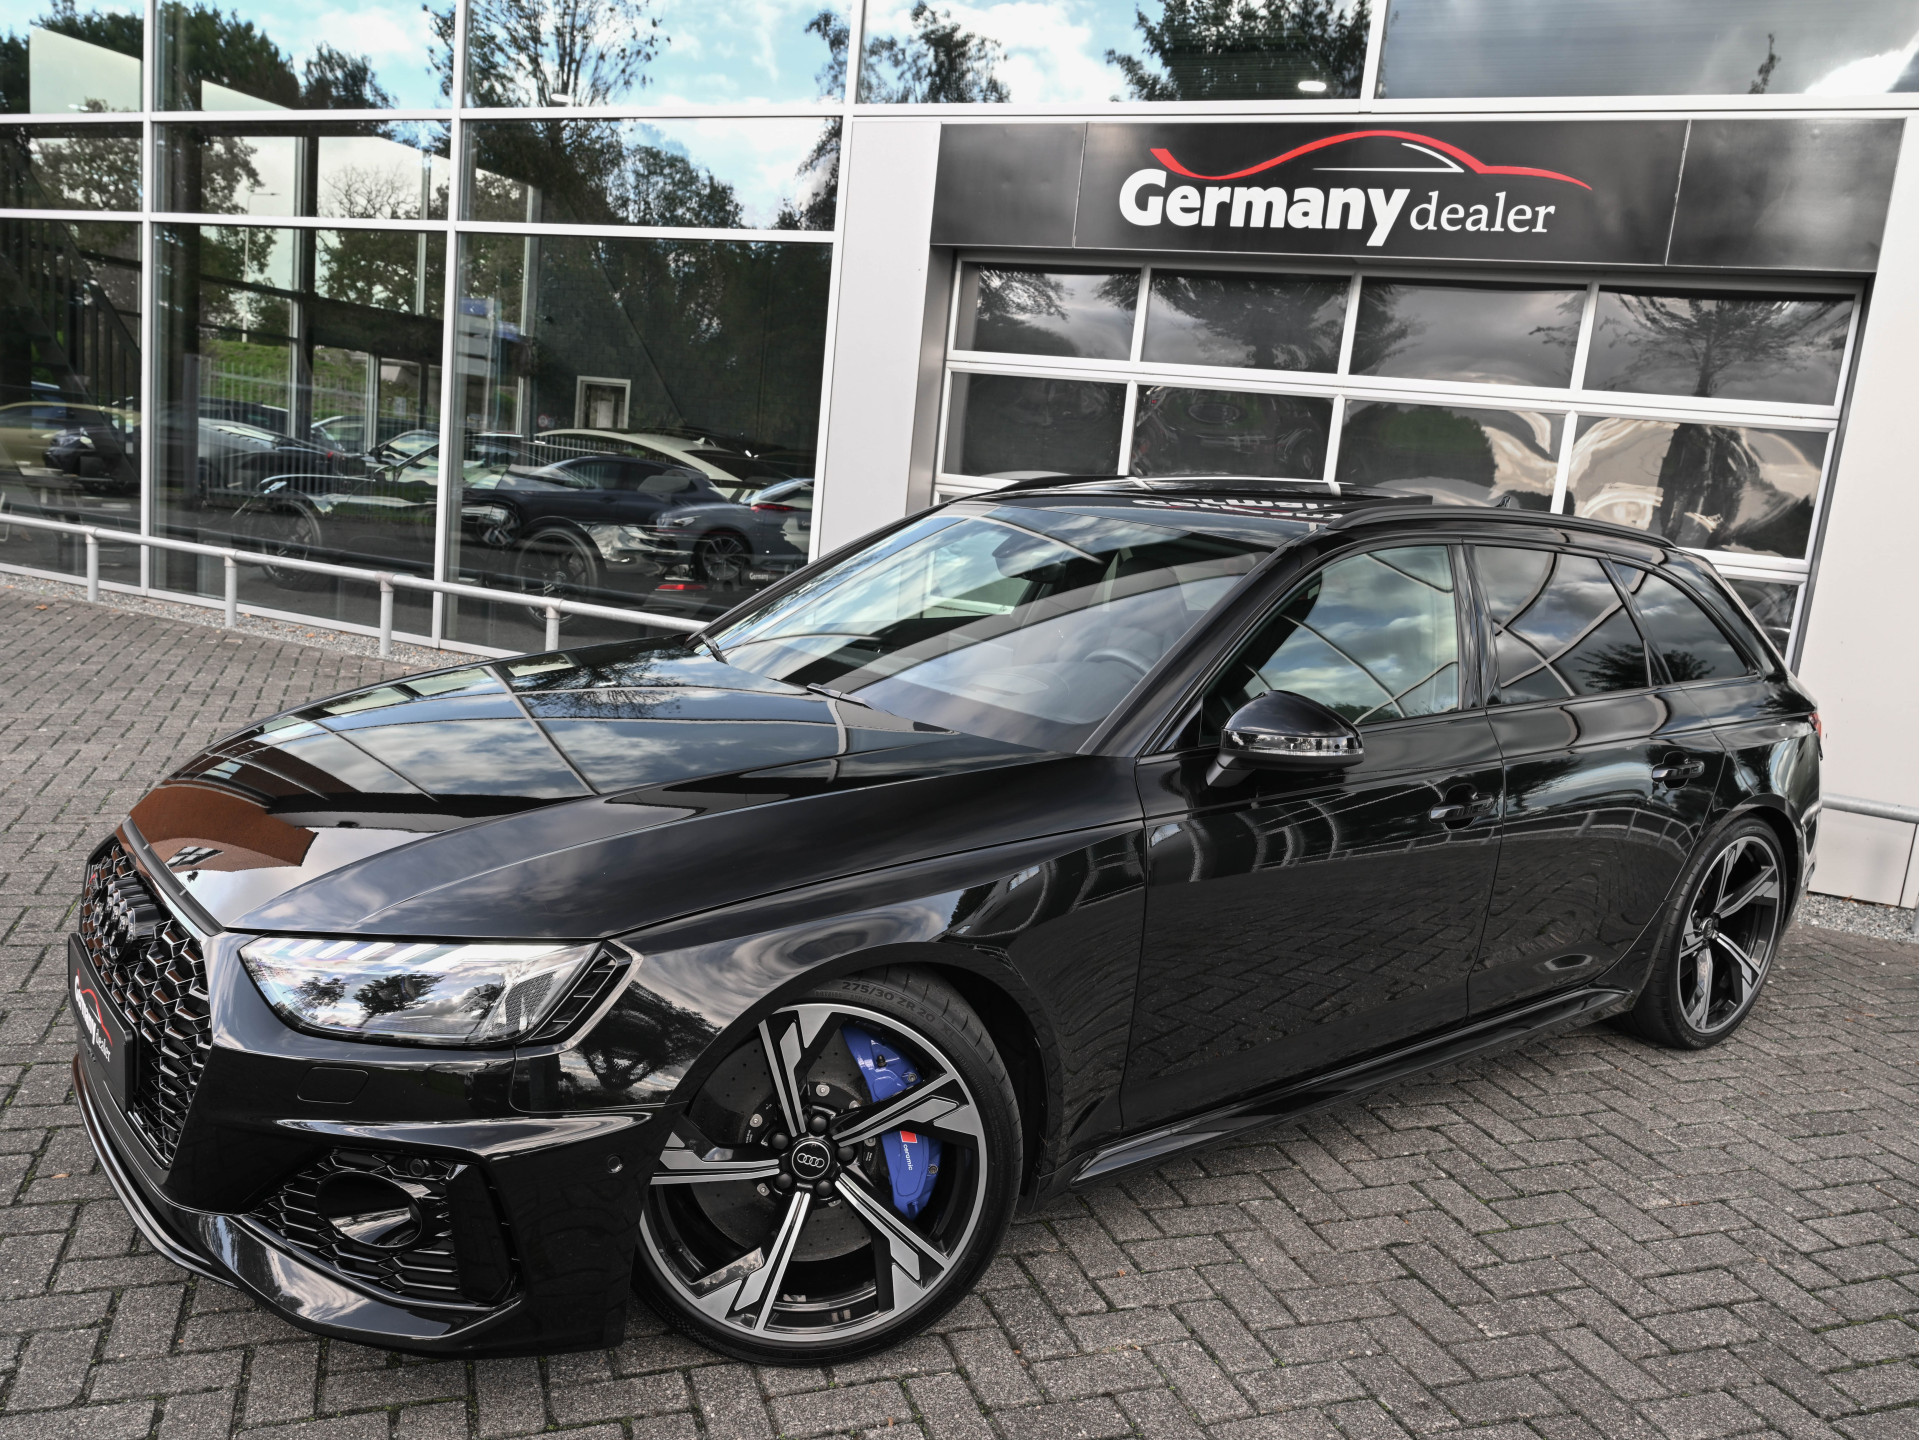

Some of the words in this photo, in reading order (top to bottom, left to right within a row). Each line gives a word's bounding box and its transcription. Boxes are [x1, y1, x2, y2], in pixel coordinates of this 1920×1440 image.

[1119, 169, 1410, 246] Germany
[1410, 191, 1555, 232] dealer
[842, 981, 894, 1001] 275/30
[897, 997, 916, 1012] ZR
[917, 1007, 936, 1023] 20
[903, 1143, 914, 1171] ceramic
